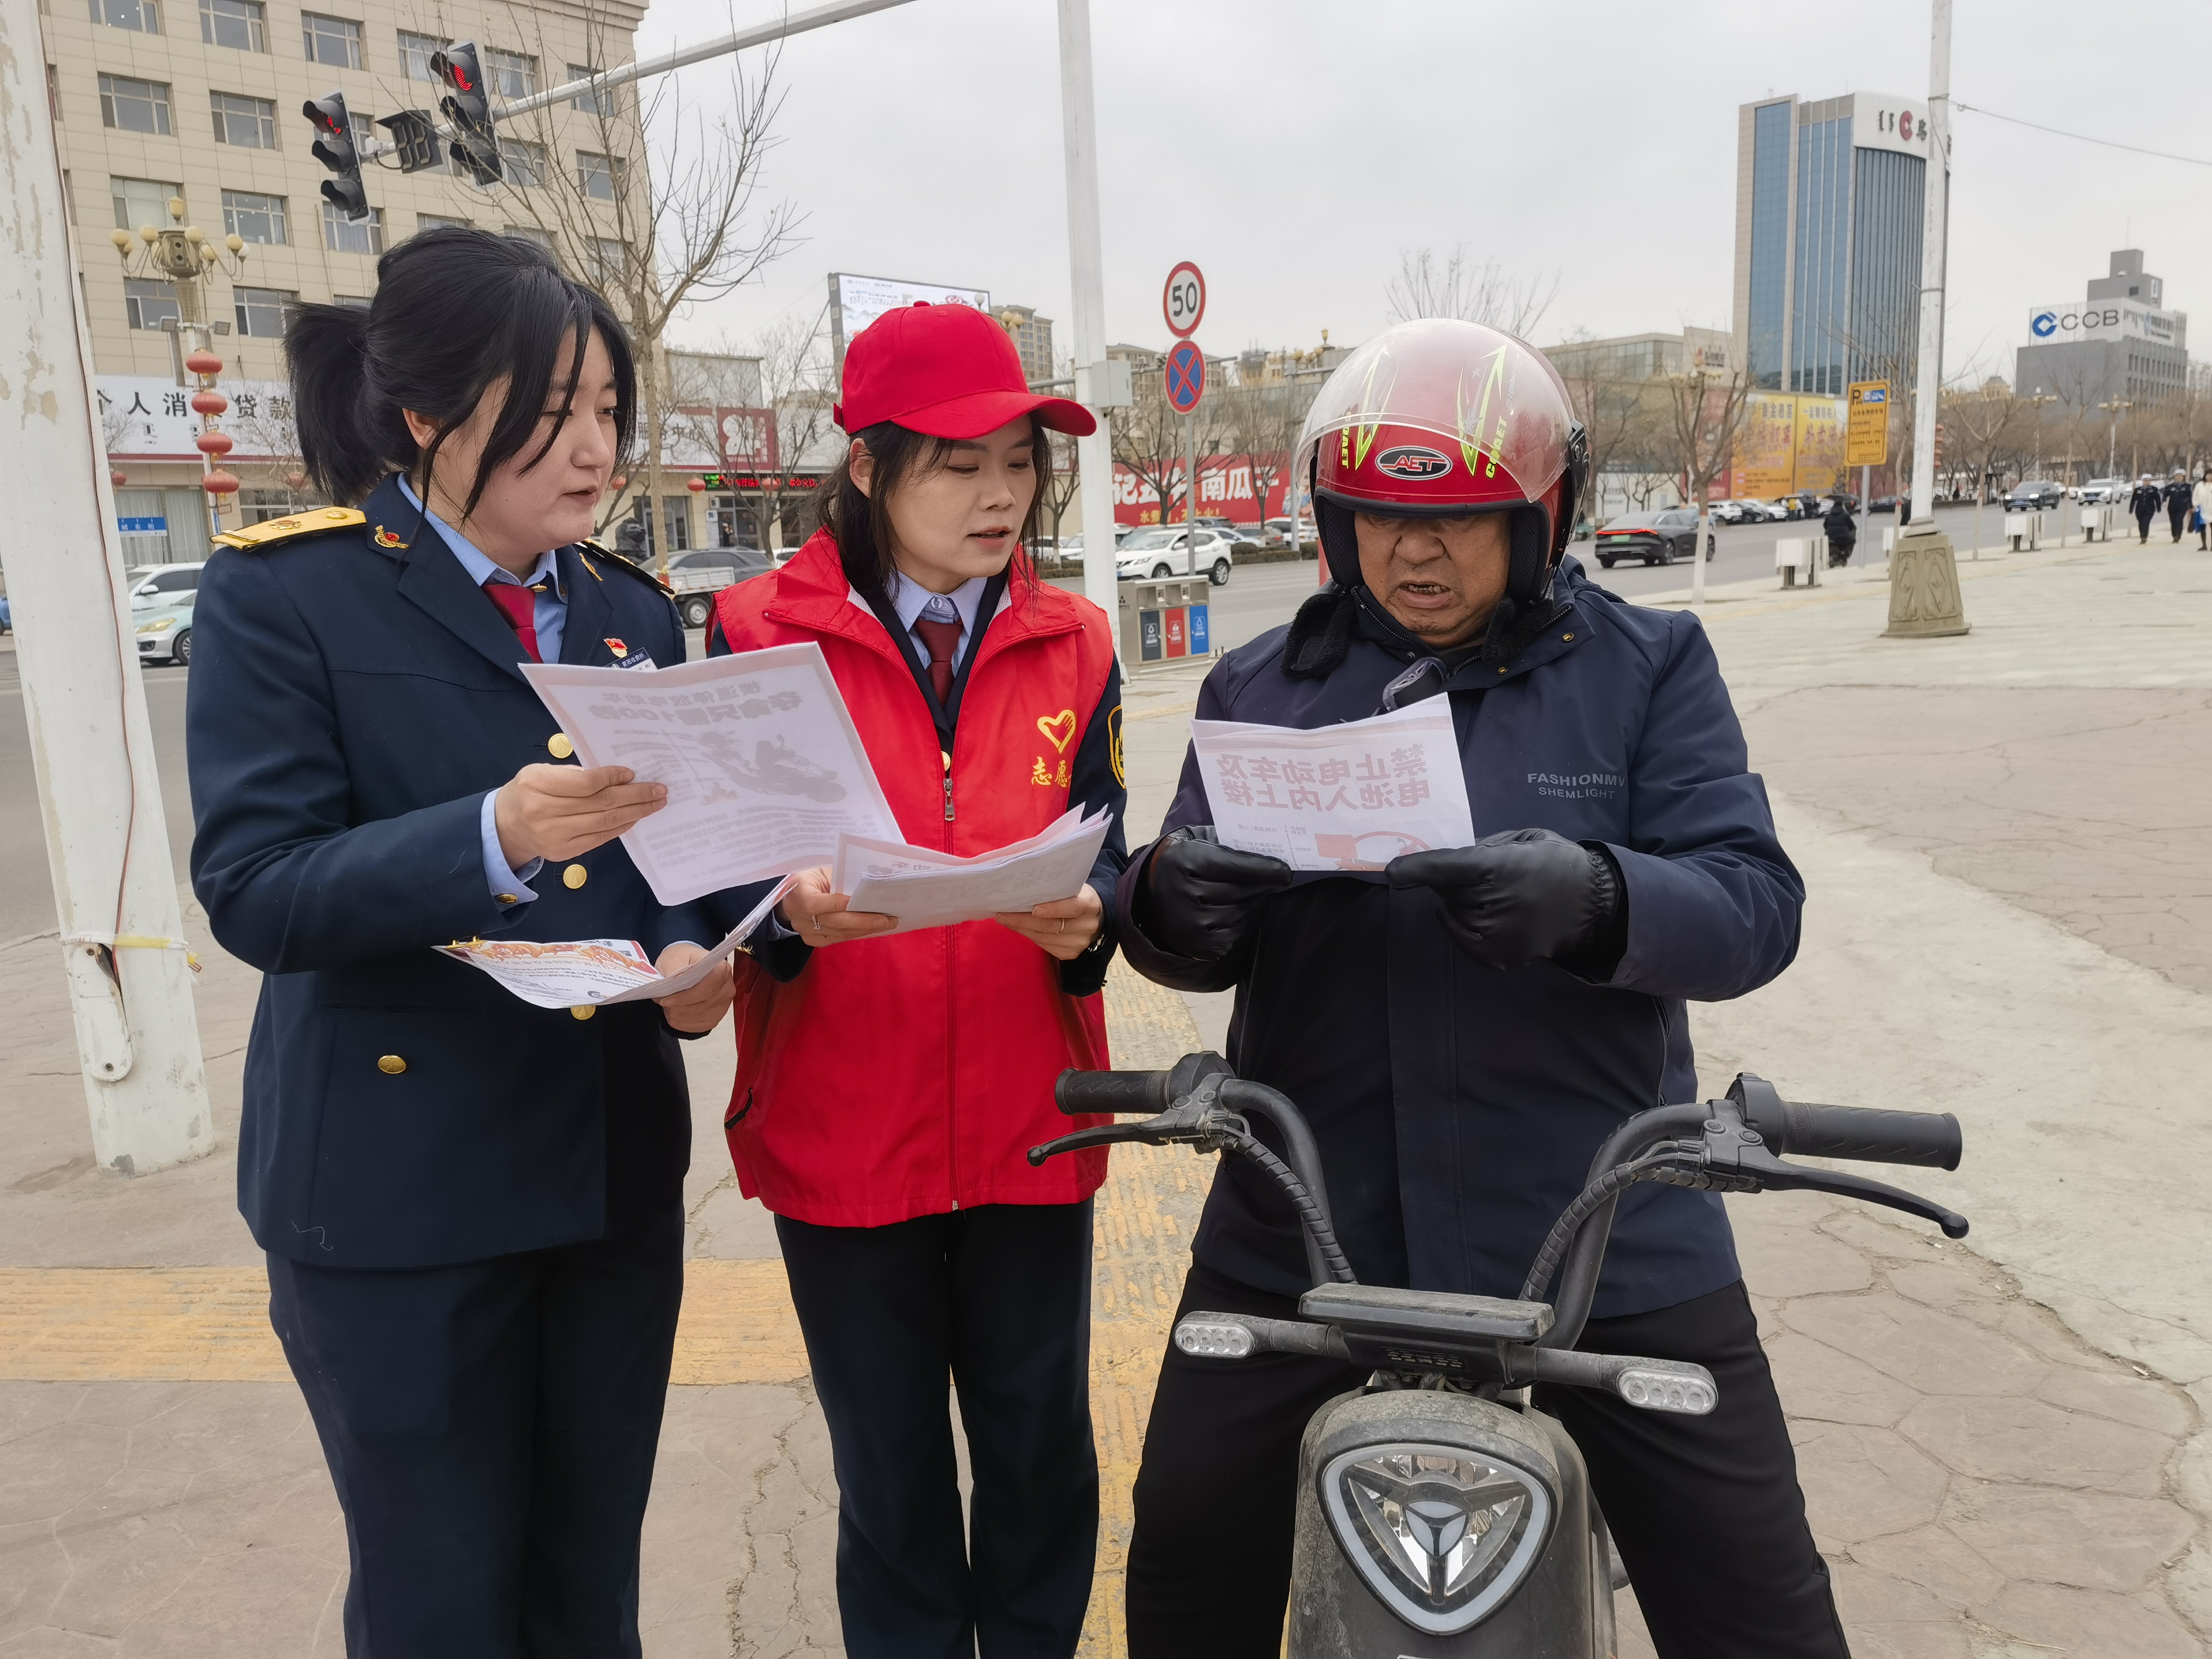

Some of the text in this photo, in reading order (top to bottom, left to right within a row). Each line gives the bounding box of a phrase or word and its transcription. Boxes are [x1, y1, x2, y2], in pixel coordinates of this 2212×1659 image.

[1172, 282, 1197, 317] 50
[2061, 310, 2119, 331] CCB
[97, 389, 293, 420] 个人消贷款
[1381, 455, 1446, 471] AET
[1031, 757, 1071, 788] 志愿
[1539, 787, 1615, 799] SHEMLIGHT
